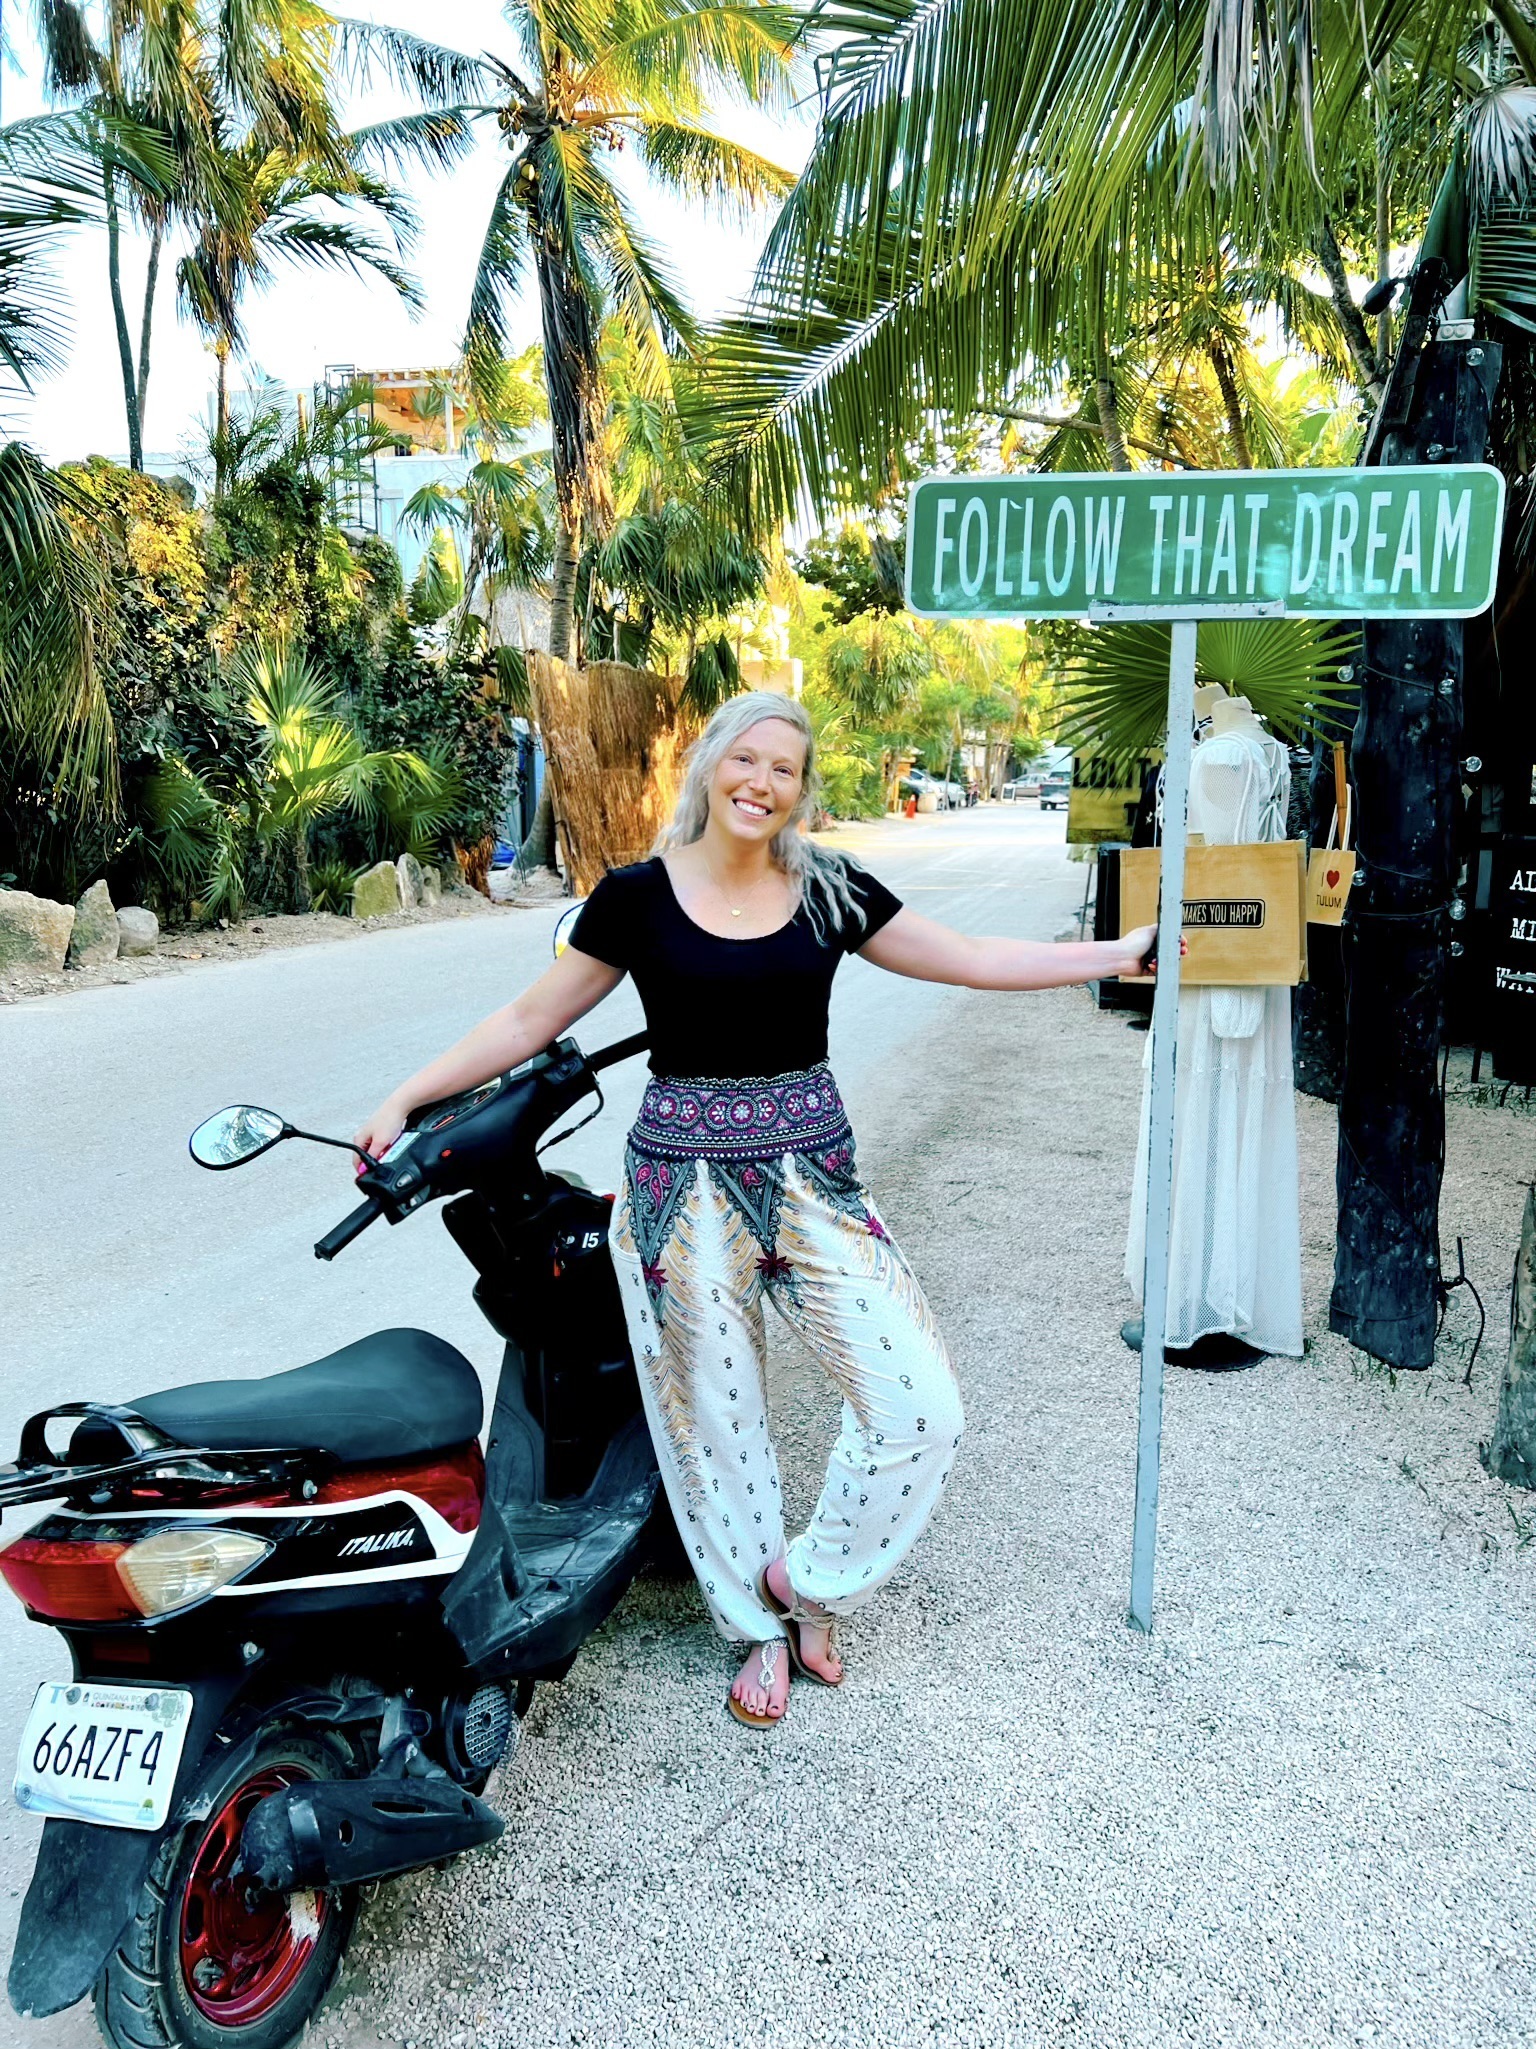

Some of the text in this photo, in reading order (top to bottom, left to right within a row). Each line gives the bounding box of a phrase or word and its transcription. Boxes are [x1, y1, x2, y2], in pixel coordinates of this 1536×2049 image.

[933, 487, 1475, 598] FOLLOW THAT DREAM
[1316, 894, 1342, 909] TULUM
[1183, 904, 1259, 924] MAKES YOU HAPPY
[581, 1232, 600, 1249] 15
[32, 1721, 164, 1786] 66AZF4
